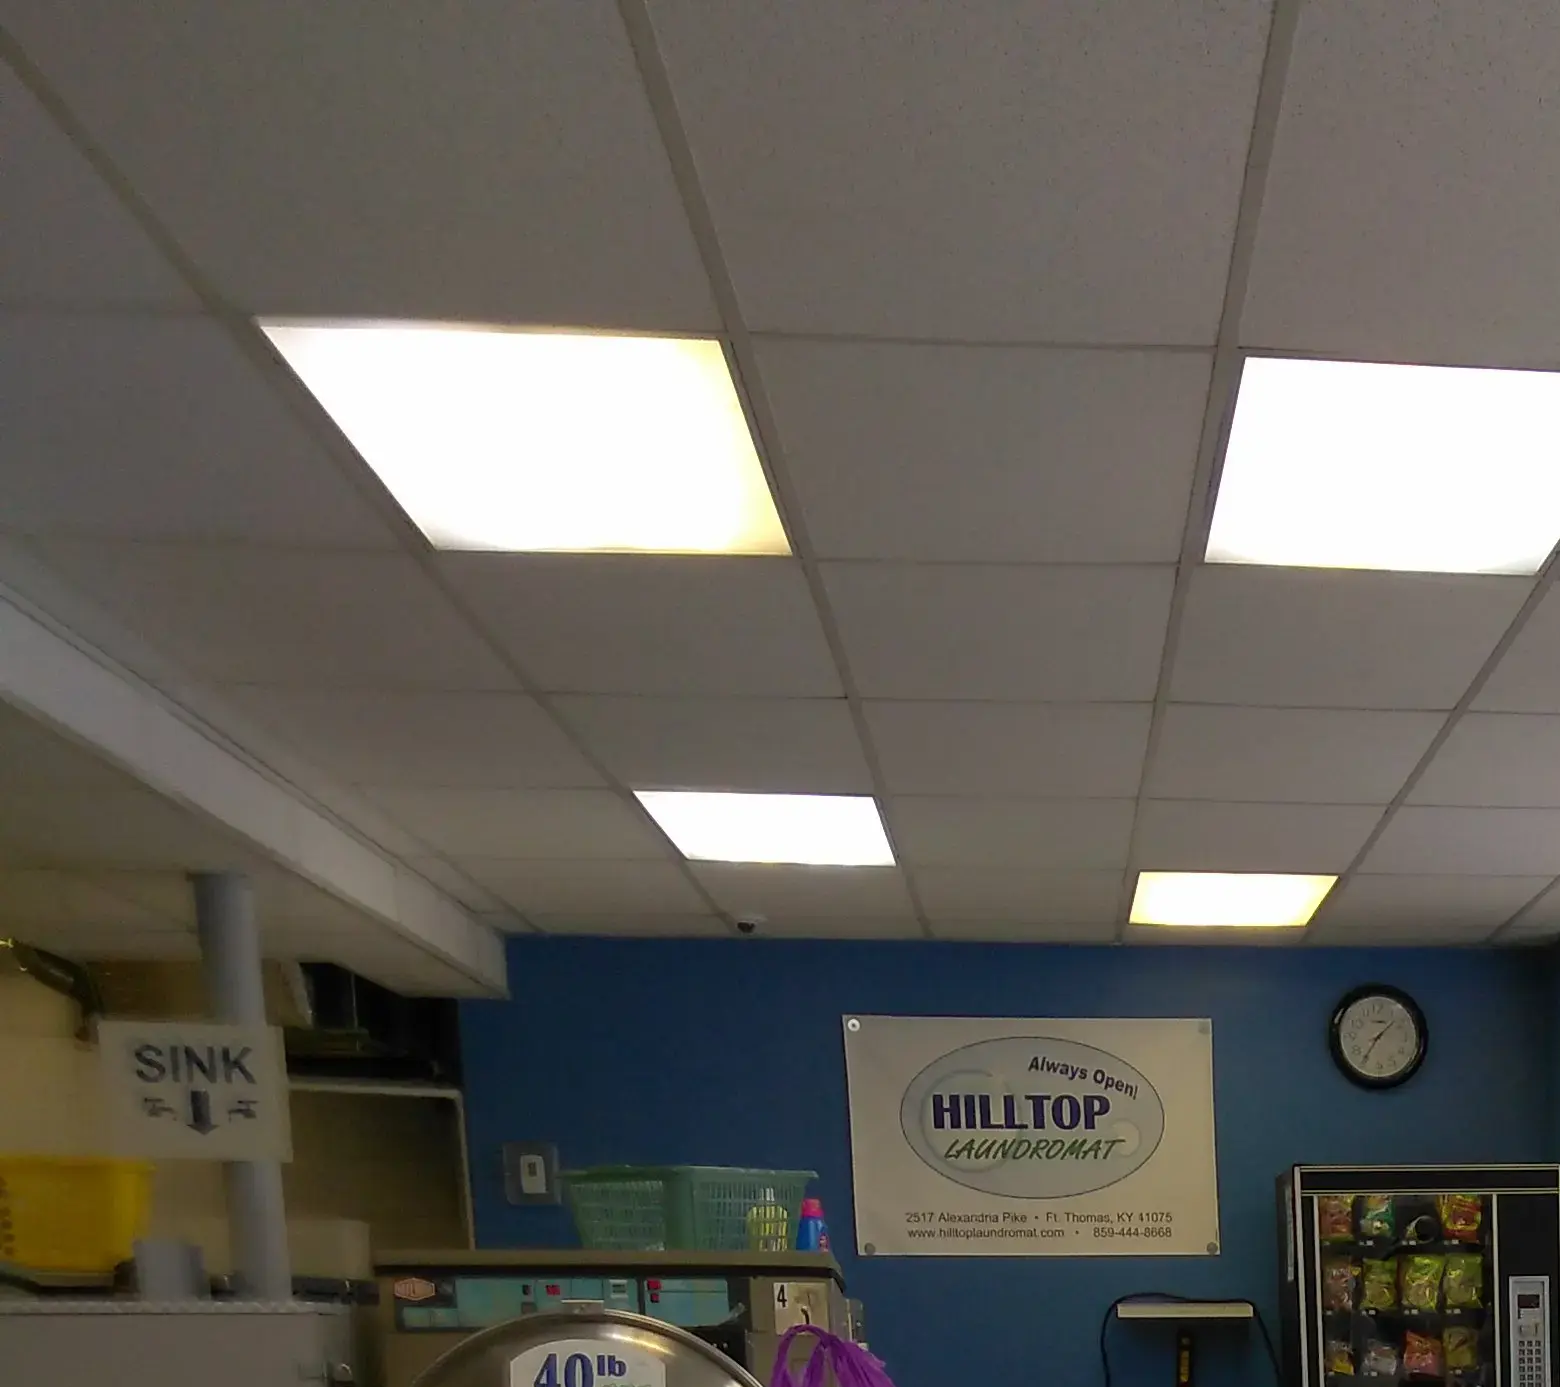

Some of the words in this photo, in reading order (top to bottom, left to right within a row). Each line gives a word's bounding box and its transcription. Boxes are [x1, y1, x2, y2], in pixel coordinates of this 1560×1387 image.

[135, 1044, 257, 1084] SINK
[1028, 1056, 1088, 1080] Always
[1093, 1069, 1139, 1100] Open!
[932, 1094, 1111, 1130] HILLTOP
[944, 1139, 1126, 1160] LAUNDROMAT
[906, 1212, 934, 1223] 2517
[938, 1212, 999, 1223] Alexandria
[1003, 1212, 1028, 1223] Pike
[1065, 1212, 1114, 1225] Thomas,
[1118, 1212, 1135, 1223] KY
[1139, 1212, 1173, 1223] 41075
[907, 1228, 1066, 1240] www.hilltoplaundromat.com
[776, 1284, 788, 1308] 4
